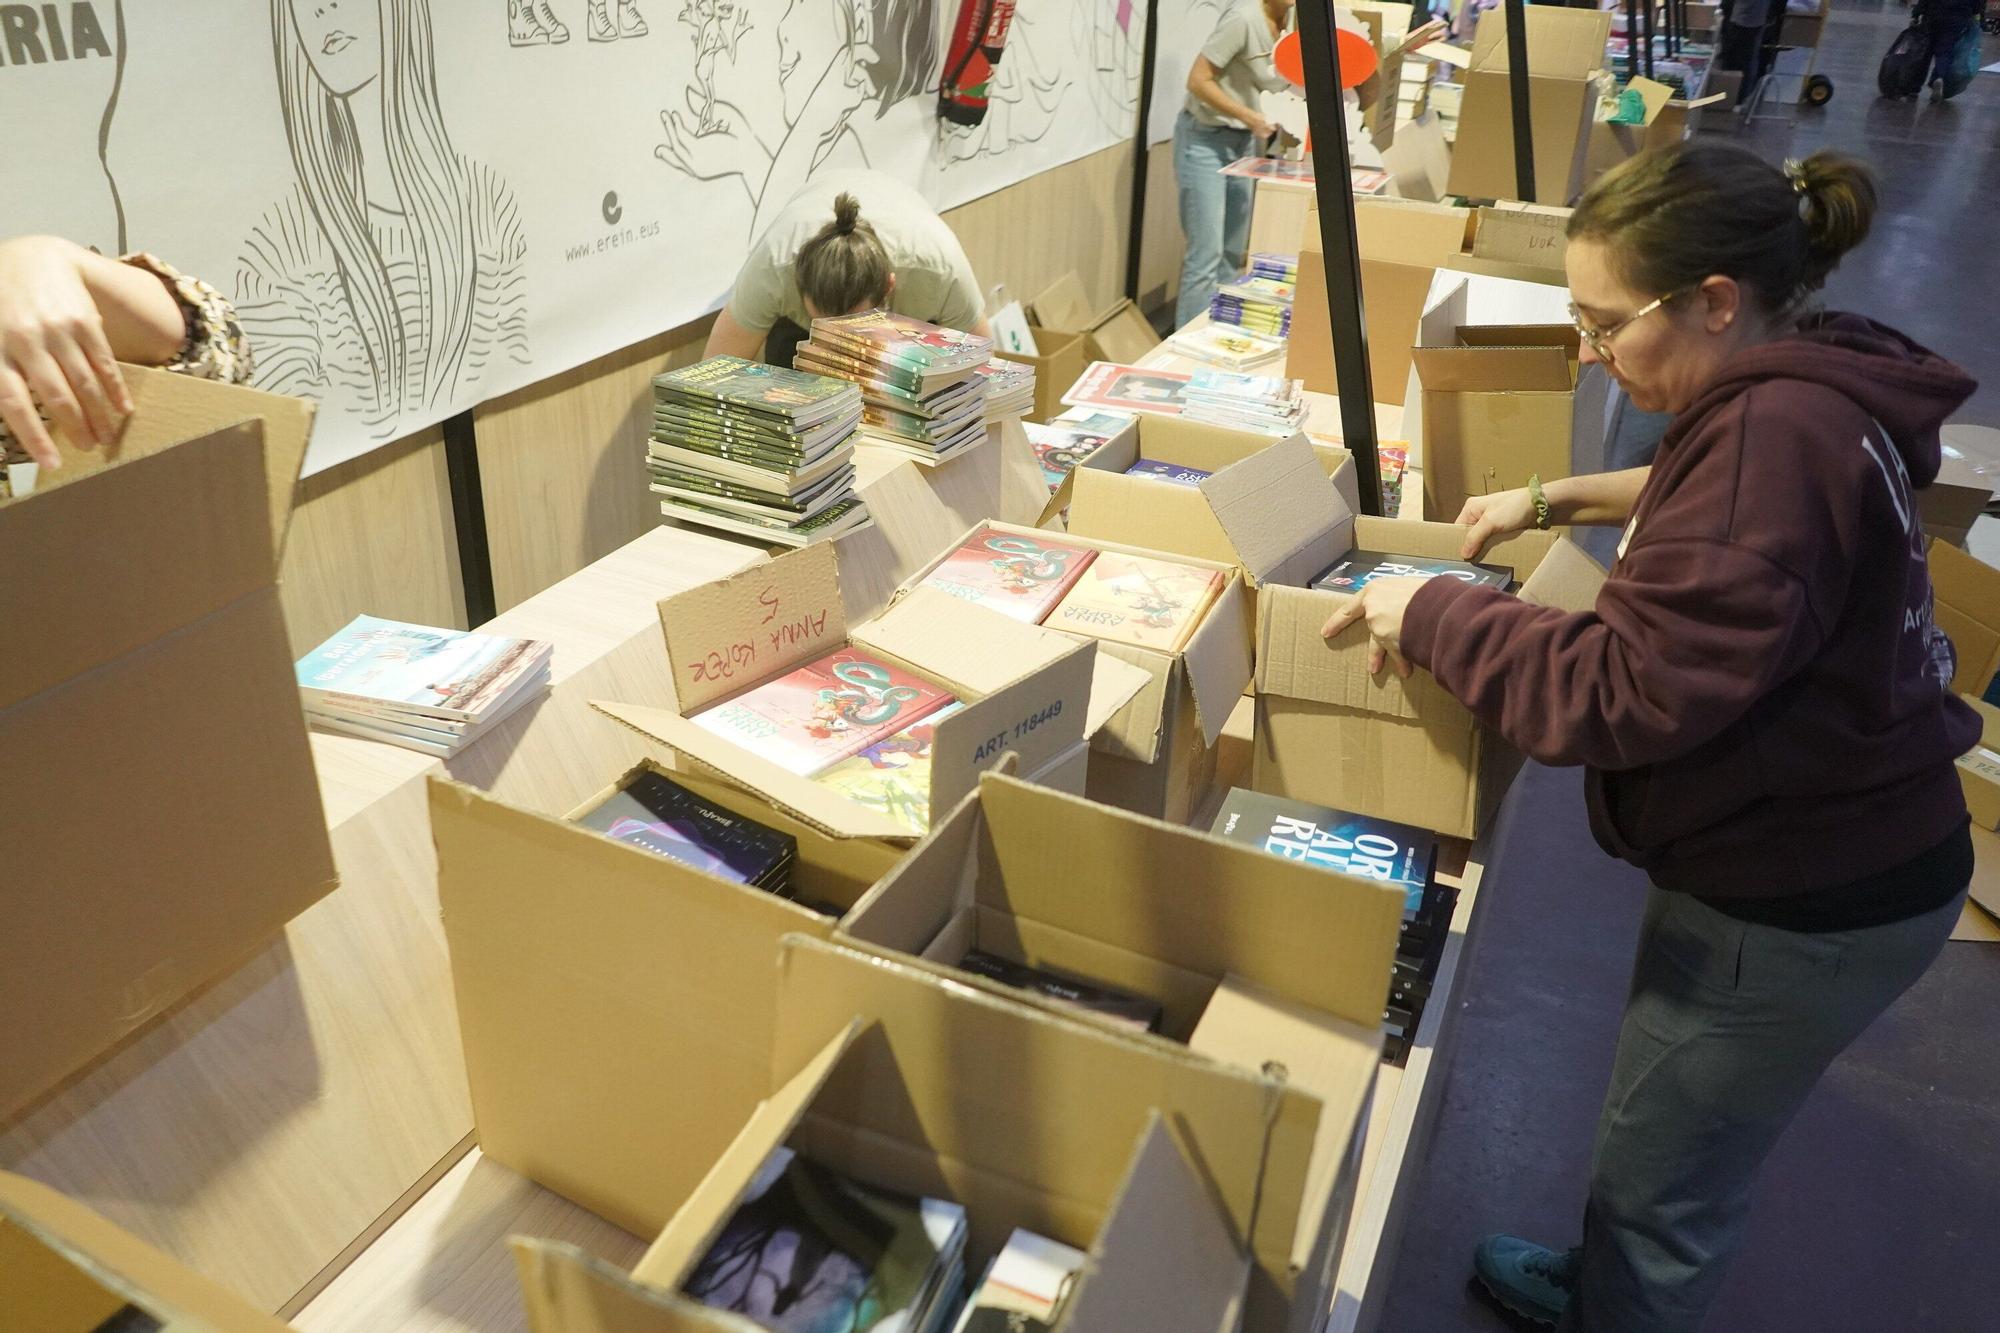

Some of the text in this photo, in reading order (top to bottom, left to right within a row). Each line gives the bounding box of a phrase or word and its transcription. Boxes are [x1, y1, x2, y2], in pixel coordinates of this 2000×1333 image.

[0, 1, 113, 67] RIA
[565, 220, 660, 262] www.erein.eus
[759, 584, 779, 625] 5
[770, 608, 827, 652] ANNA
[973, 699, 1063, 764] ART. 118449
